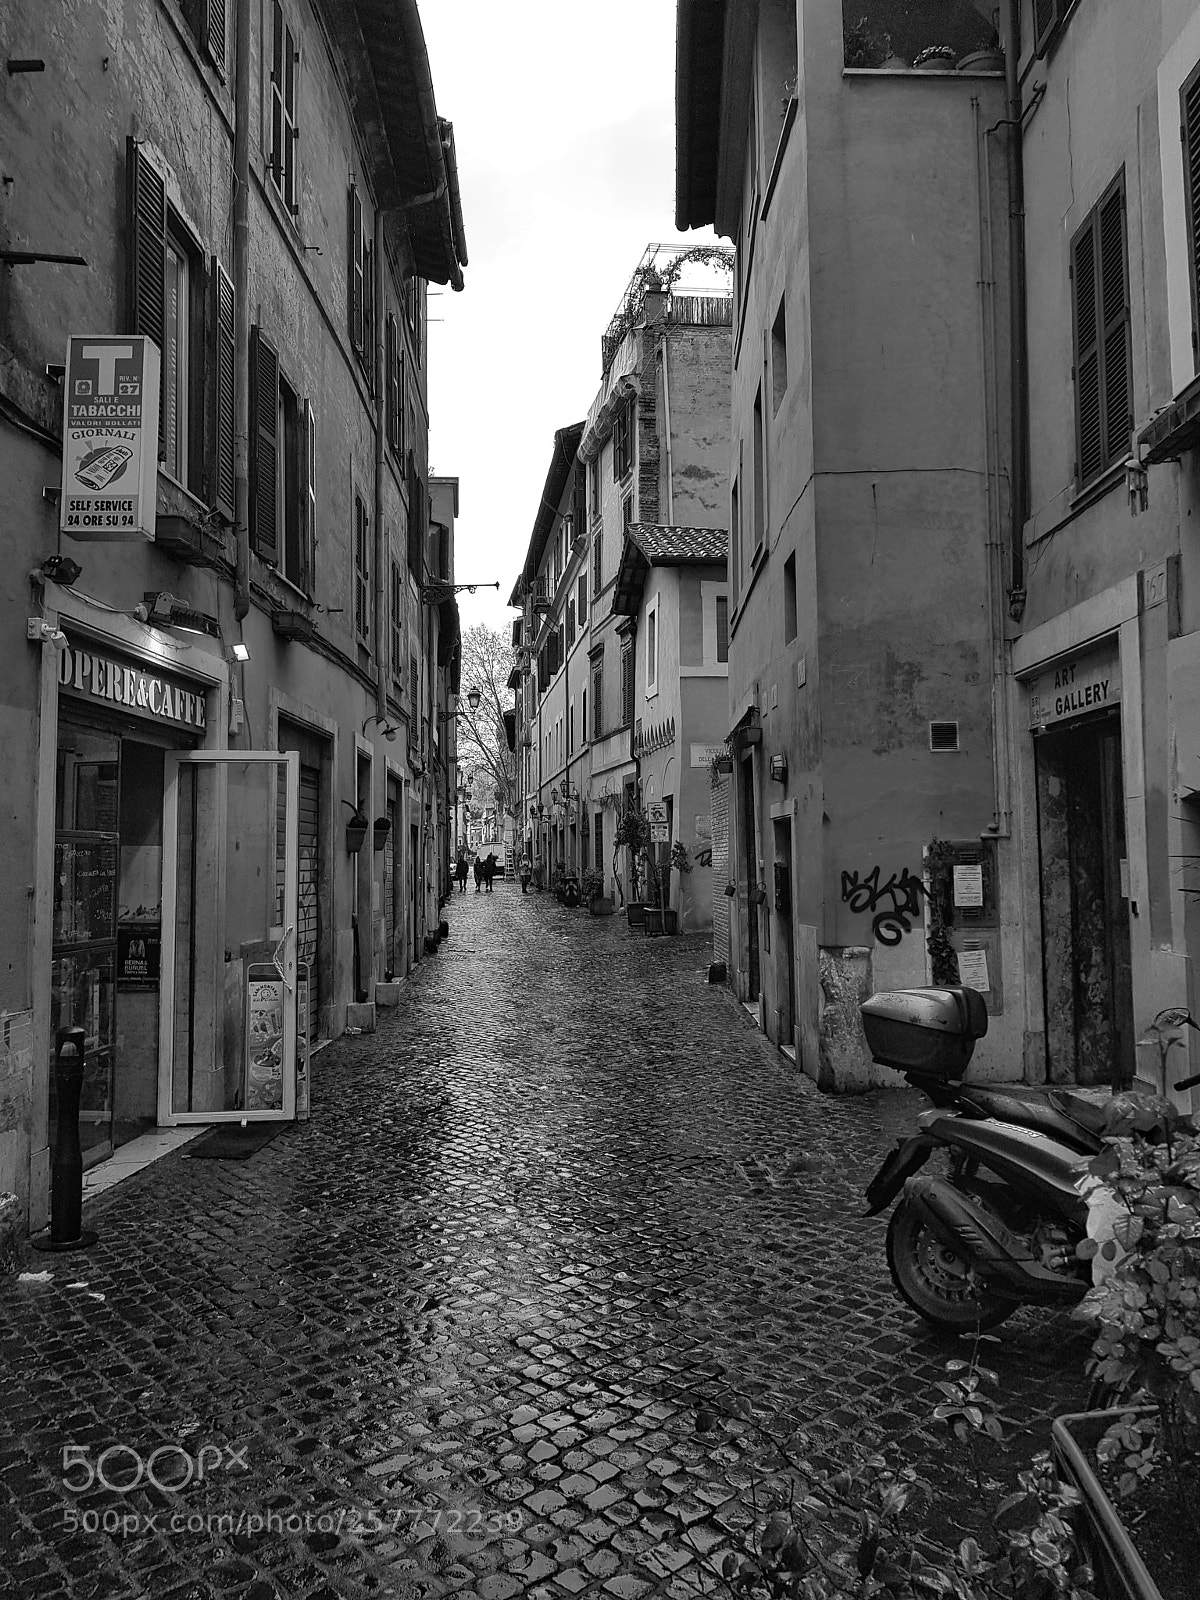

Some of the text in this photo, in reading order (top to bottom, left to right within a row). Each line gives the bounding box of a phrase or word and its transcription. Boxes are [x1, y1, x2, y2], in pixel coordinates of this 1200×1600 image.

[82, 345, 133, 396] T
[120, 384, 138, 394] 27
[93, 396, 120, 404] SALI E
[71, 404, 141, 417] TABACCHI
[71, 428, 136, 441] GIORNALI
[69, 500, 133, 512] SELF SERVICE
[67, 515, 134, 526] 24 ORE SU 24
[1054, 663, 1077, 690] ART
[1055, 679, 1109, 716] GALLERY
